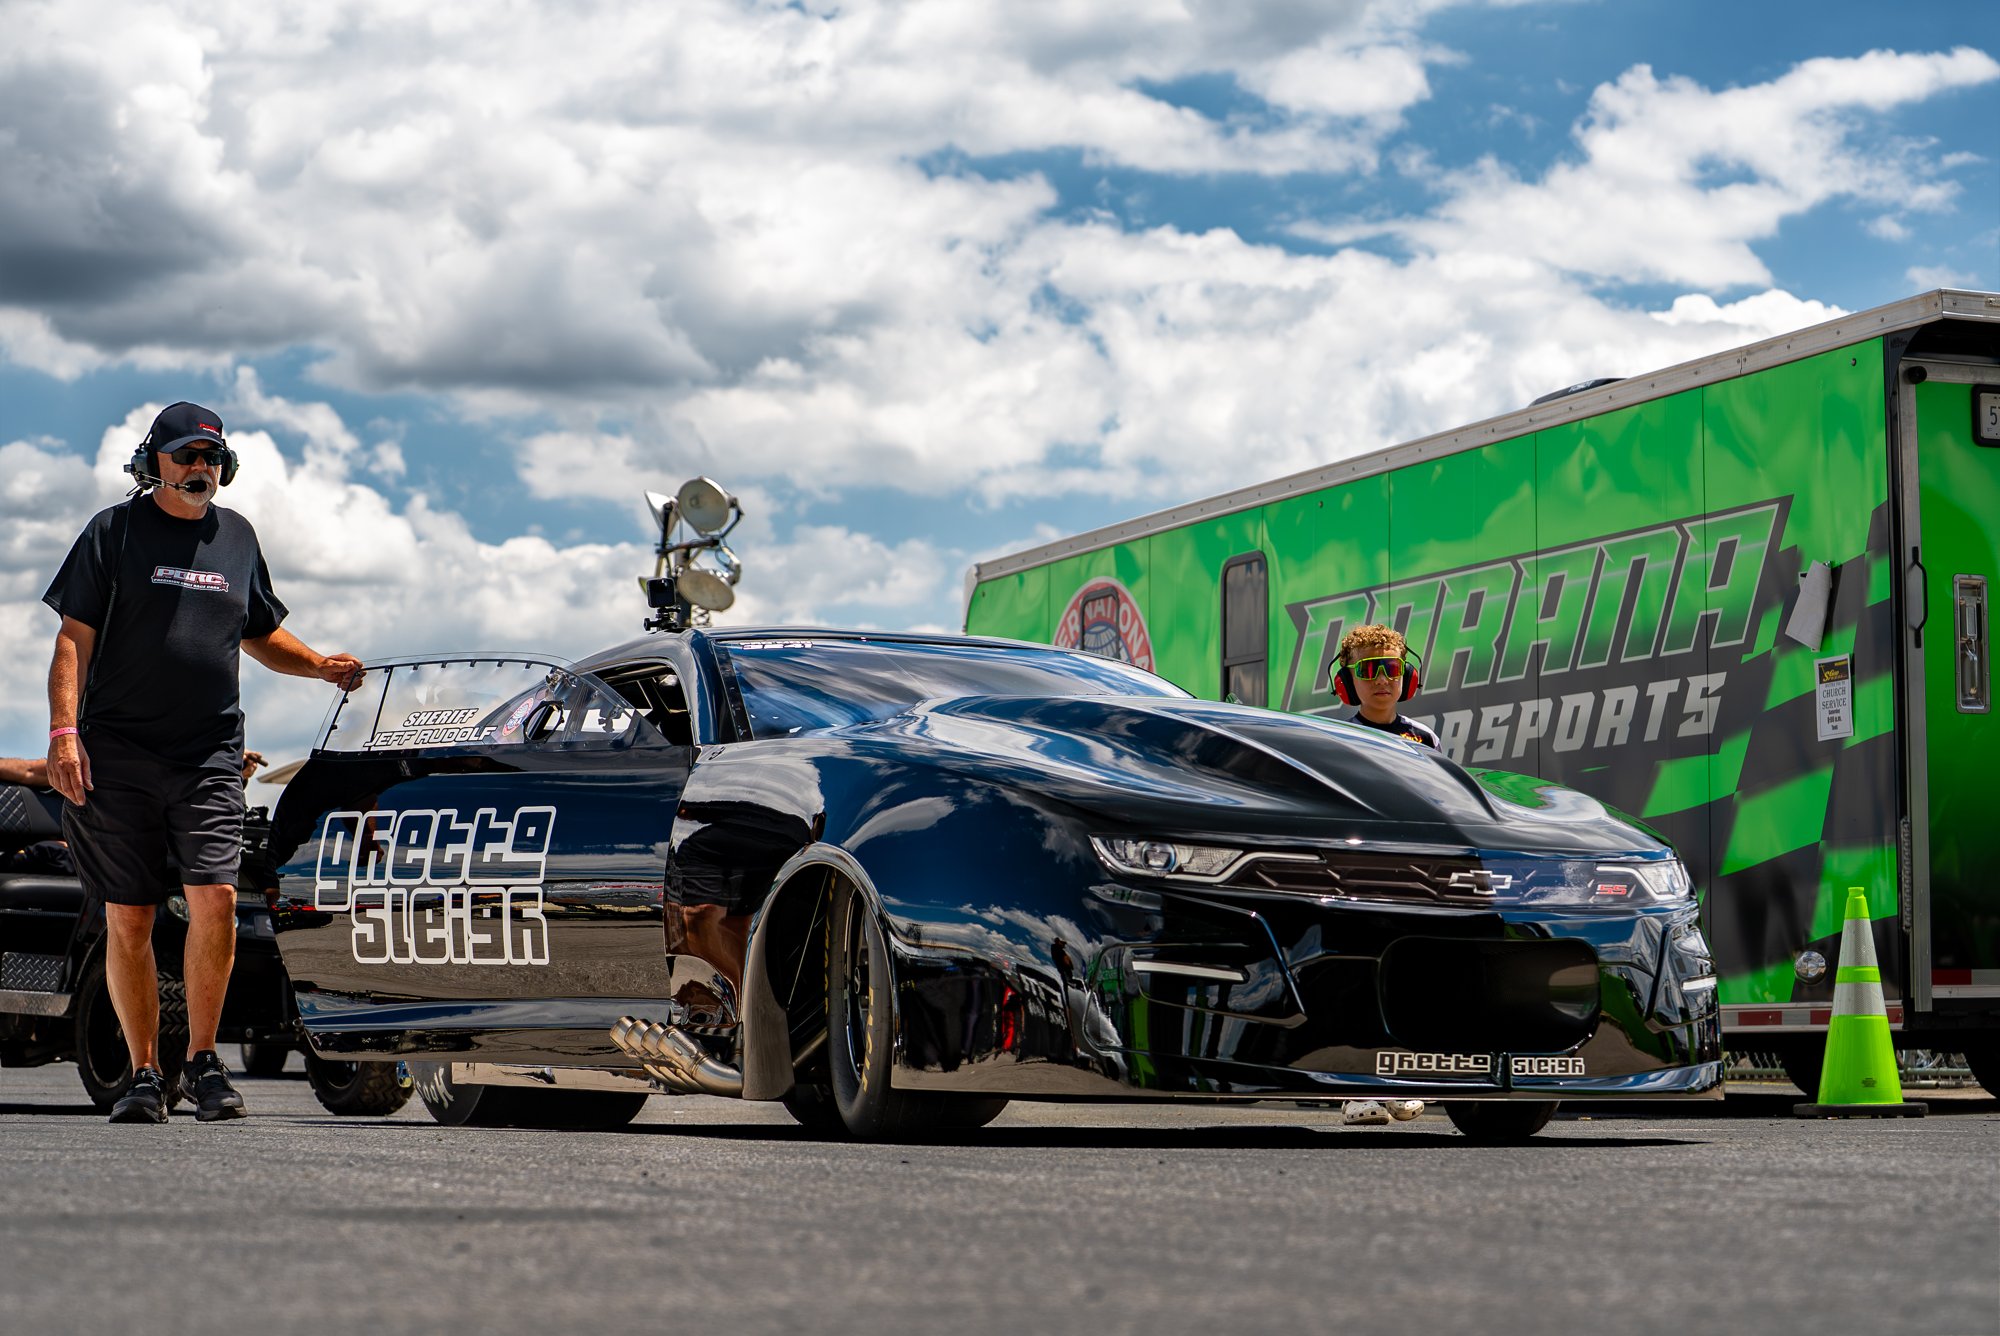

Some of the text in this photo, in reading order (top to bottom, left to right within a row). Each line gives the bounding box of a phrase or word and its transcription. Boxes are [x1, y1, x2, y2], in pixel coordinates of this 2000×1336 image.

[1822, 687, 1846, 698] CHURCH
[1822, 698, 1847, 710] SERVICE
[403, 708, 479, 727] SHERIFF
[363, 726, 498, 747] JEFF RUDOLF
[1596, 884, 1627, 894] SS
